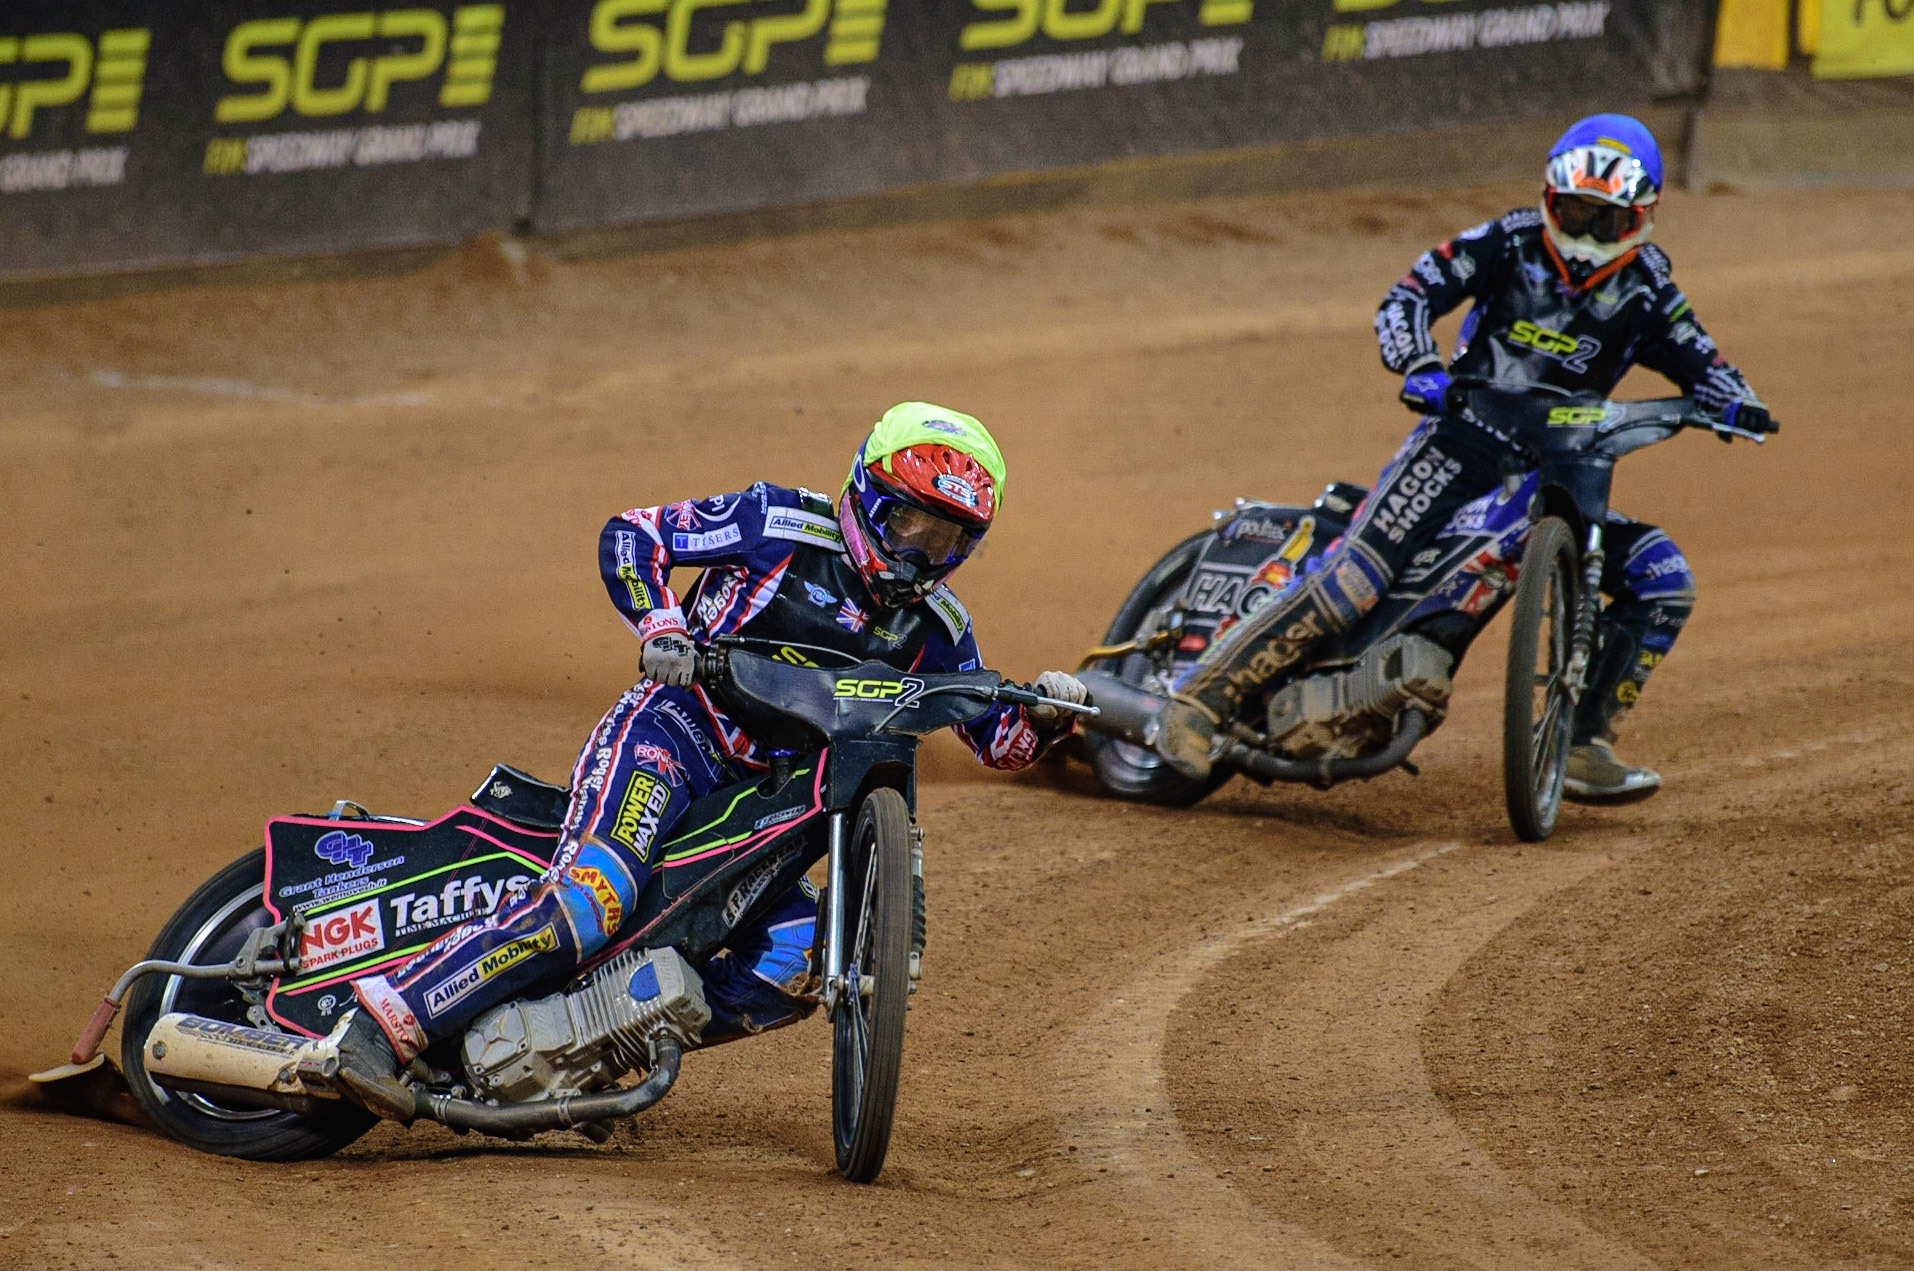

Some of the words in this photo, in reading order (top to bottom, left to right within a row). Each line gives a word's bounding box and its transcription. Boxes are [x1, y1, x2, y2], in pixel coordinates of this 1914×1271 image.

[1372, 444, 1446, 535] HAGON
[1387, 457, 1463, 545] SHOCKS
[692, 528, 740, 547] TYSERS
[772, 516, 804, 530] Allied
[621, 532, 632, 565] Allied
[833, 676, 925, 709] SGP2
[617, 776, 655, 844] POWER
[634, 784, 667, 857] MAXED
[279, 877, 323, 898] Grant
[325, 855, 405, 885] Henderson
[312, 876, 369, 898] Tankers
[390, 875, 530, 928] Taffys
[570, 867, 621, 937] SMYTHS
[299, 905, 376, 957] NGK
[302, 949, 339, 969] SPARK
[341, 938, 379, 957] PLUGS
[431, 964, 481, 1010] Allied
